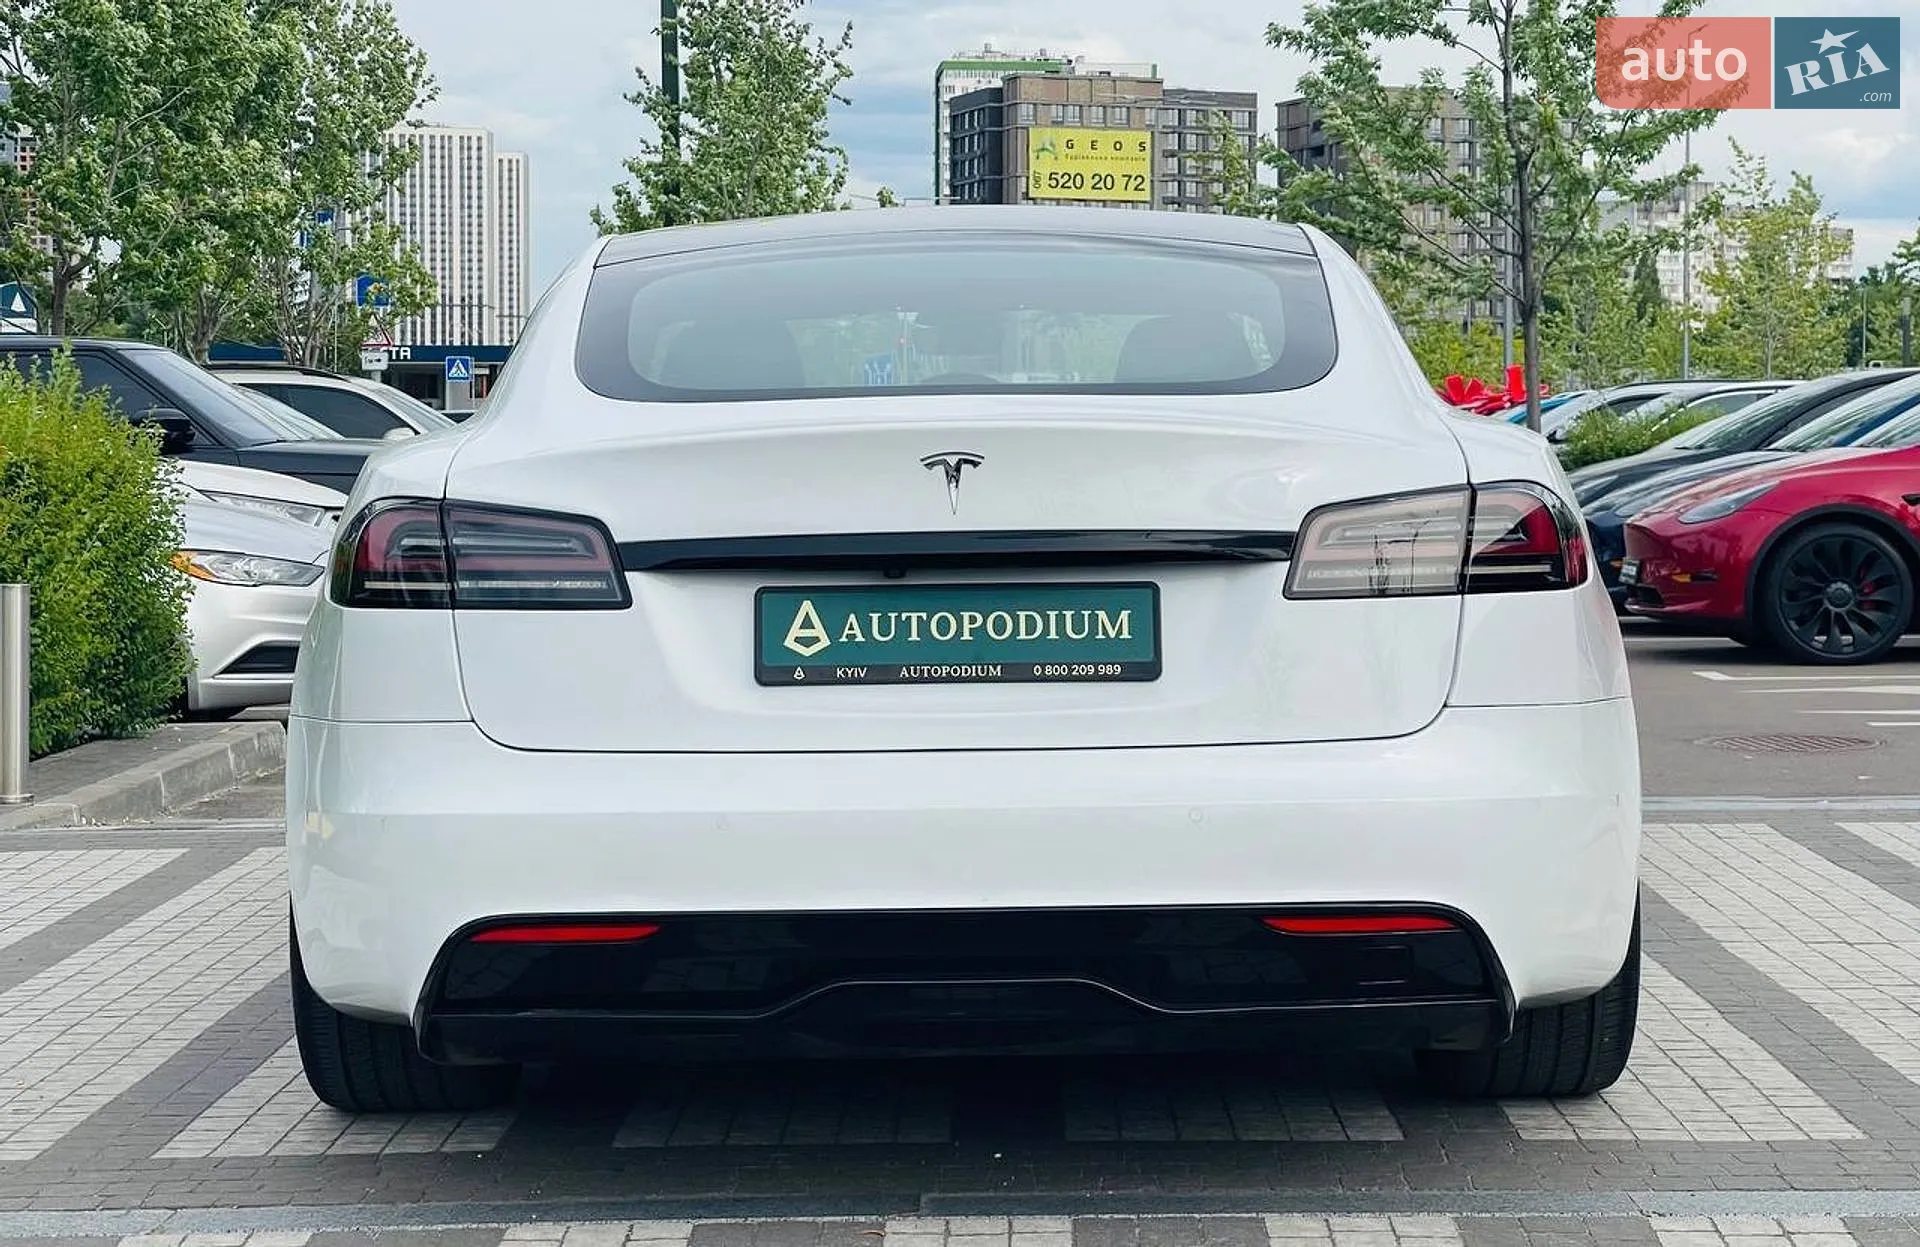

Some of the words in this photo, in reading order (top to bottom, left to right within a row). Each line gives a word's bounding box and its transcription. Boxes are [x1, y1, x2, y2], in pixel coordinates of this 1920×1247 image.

[1066, 139, 1146, 152] GEOS
[1048, 171, 1084, 190] 520
[1091, 173, 1115, 191] 20
[1122, 174, 1146, 192] 72
[839, 610, 1132, 642] AUTOPODIUM
[836, 667, 868, 678] KYIV
[900, 665, 1001, 678] AUTOPODIUM
[1033, 665, 1042, 677] 0
[1045, 665, 1068, 676] 800
[1071, 664, 1095, 676] 209
[1098, 664, 1122, 676] 989
